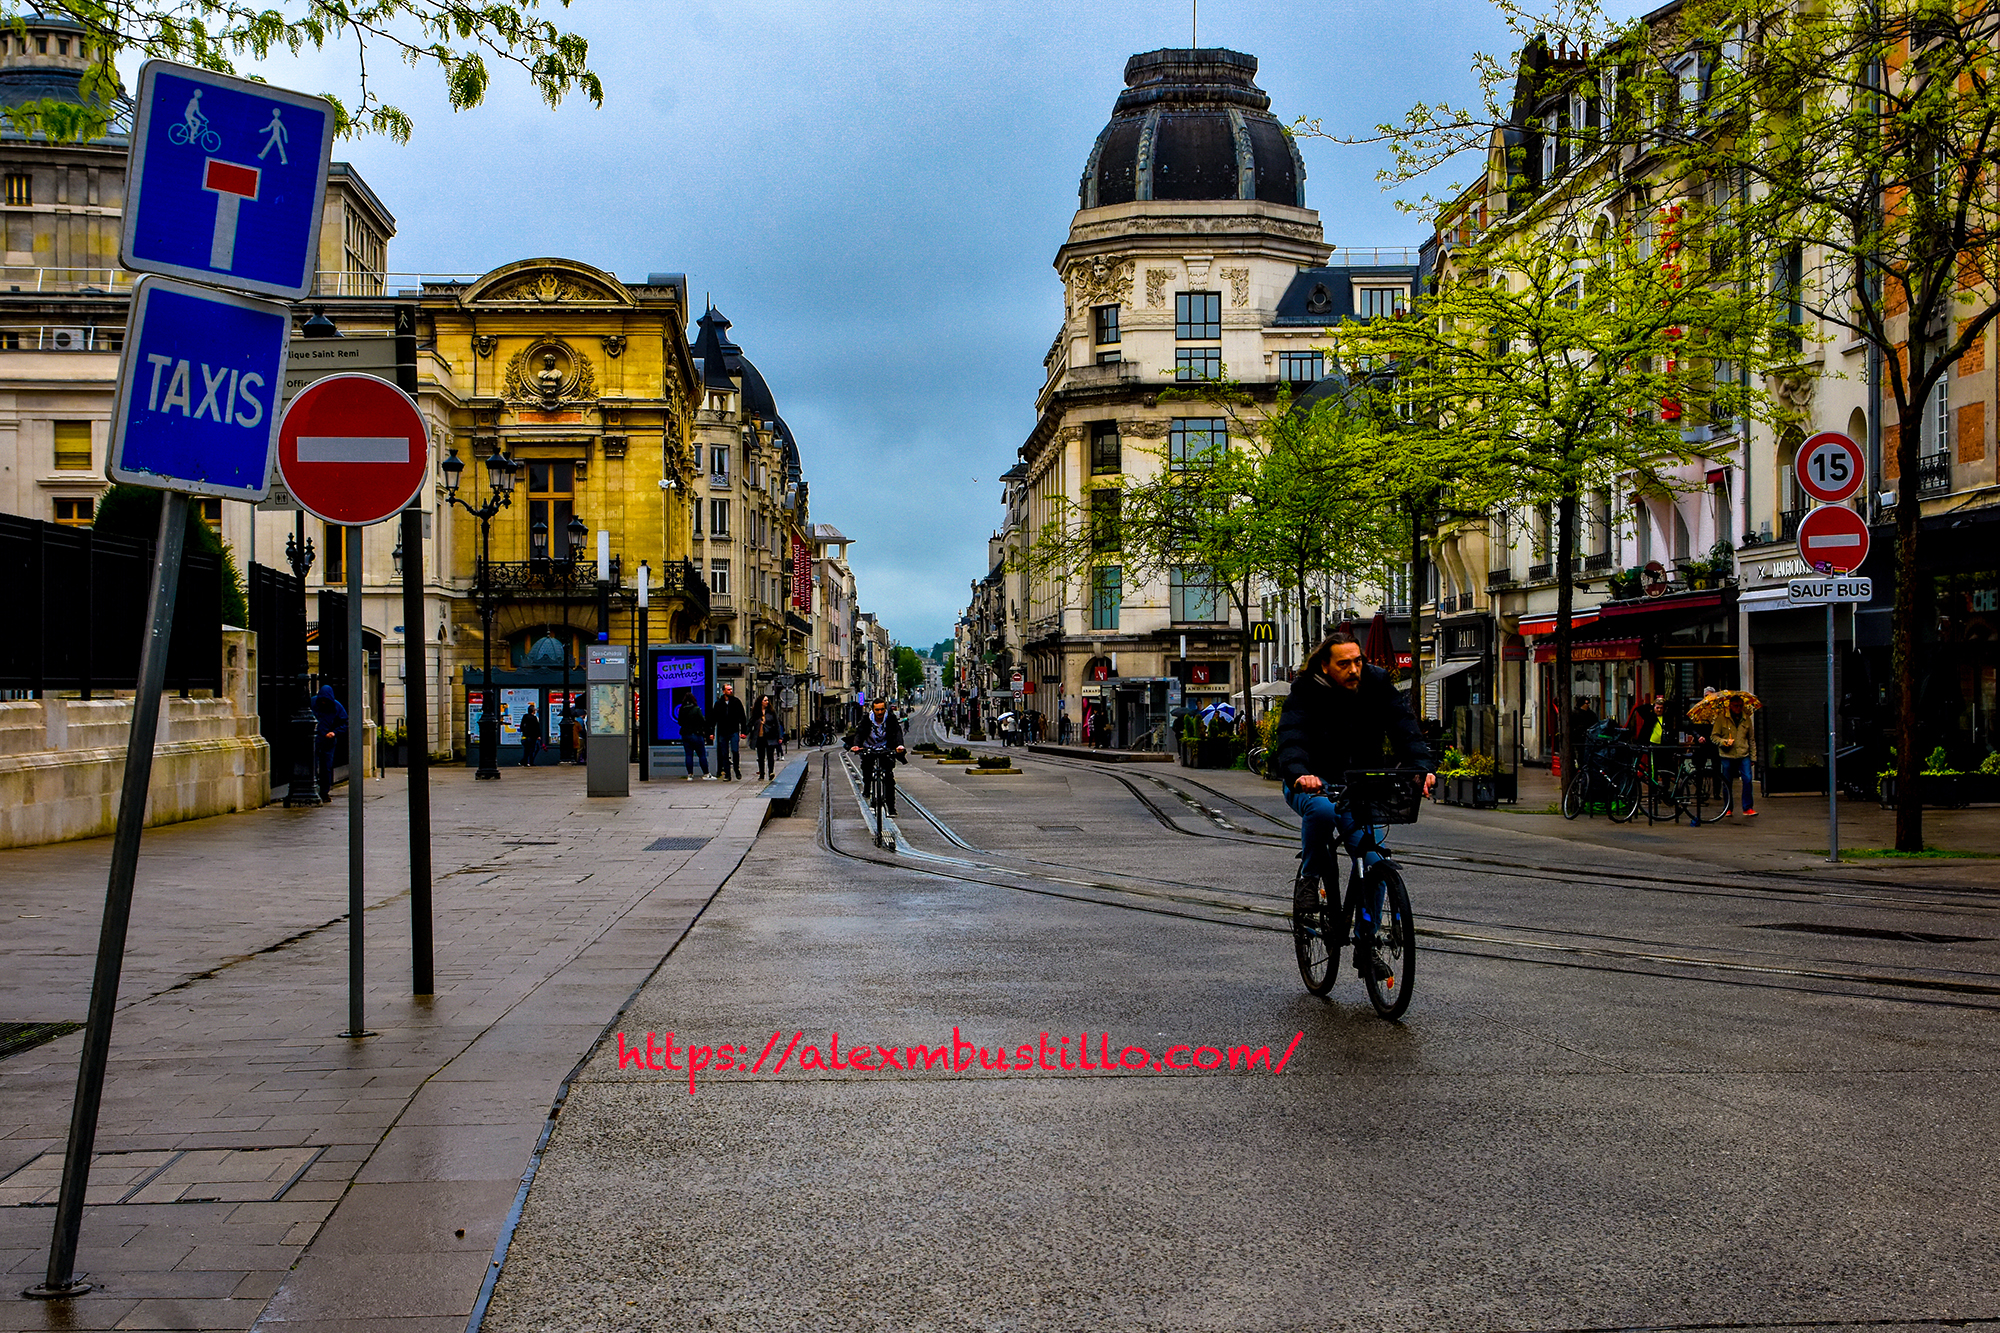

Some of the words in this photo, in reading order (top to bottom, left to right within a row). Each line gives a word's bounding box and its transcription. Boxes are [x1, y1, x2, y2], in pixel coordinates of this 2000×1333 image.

[312, 349, 335, 359] Saint
[337, 349, 359, 358] Remi
[147, 353, 265, 429] TAXIS
[1813, 453, 1849, 482] 15
[793, 564, 800, 576] du
[1790, 583, 1834, 598] SAUF
[1837, 583, 1871, 597] BUS
[1458, 629, 1476, 648] PAUL
[661, 662, 696, 672] CITUR'
